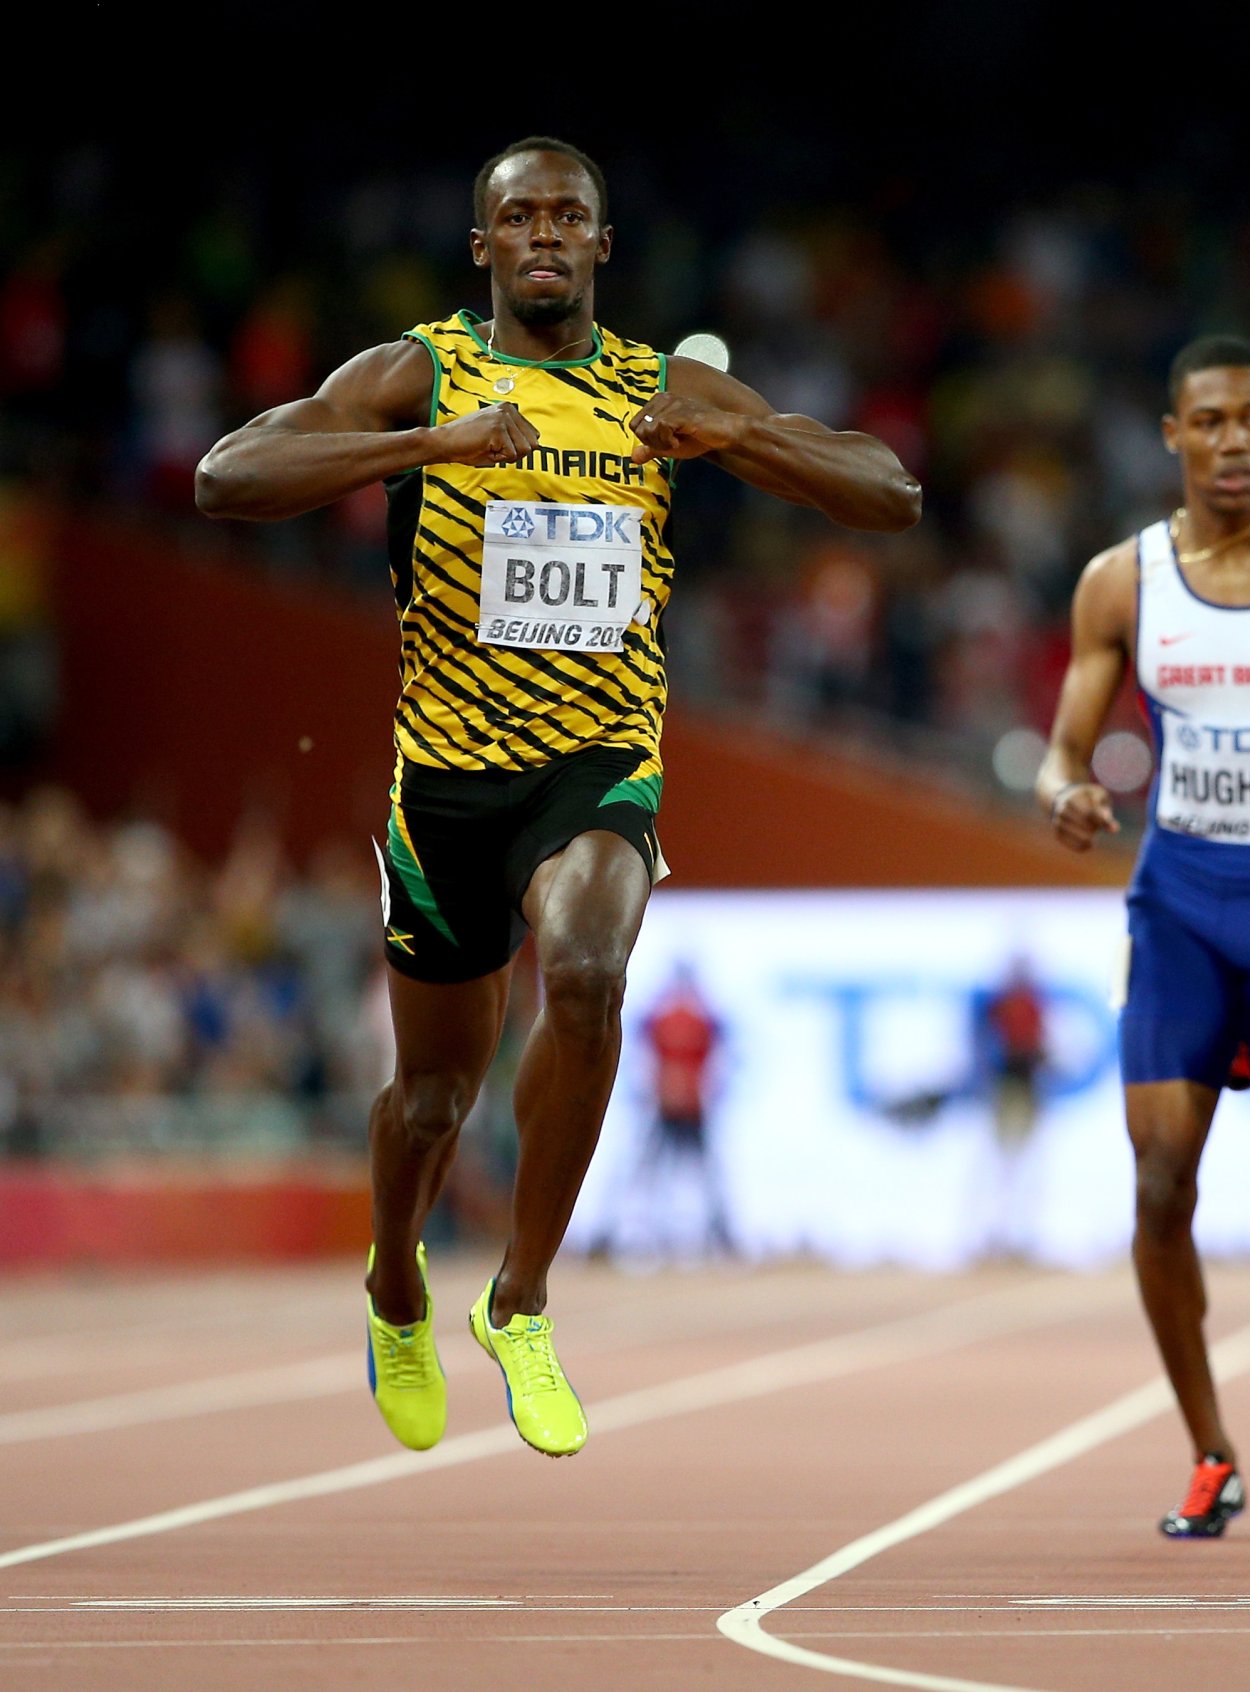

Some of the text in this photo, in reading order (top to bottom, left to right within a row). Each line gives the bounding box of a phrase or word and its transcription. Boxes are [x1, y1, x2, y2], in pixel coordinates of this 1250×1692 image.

[475, 445, 644, 486] MAICA
[535, 508, 631, 544] TDK
[504, 558, 625, 608] BOLT
[486, 618, 624, 648] BEIJING 201
[1157, 664, 1225, 687] GREAT
[775, 972, 1122, 1106] TD
